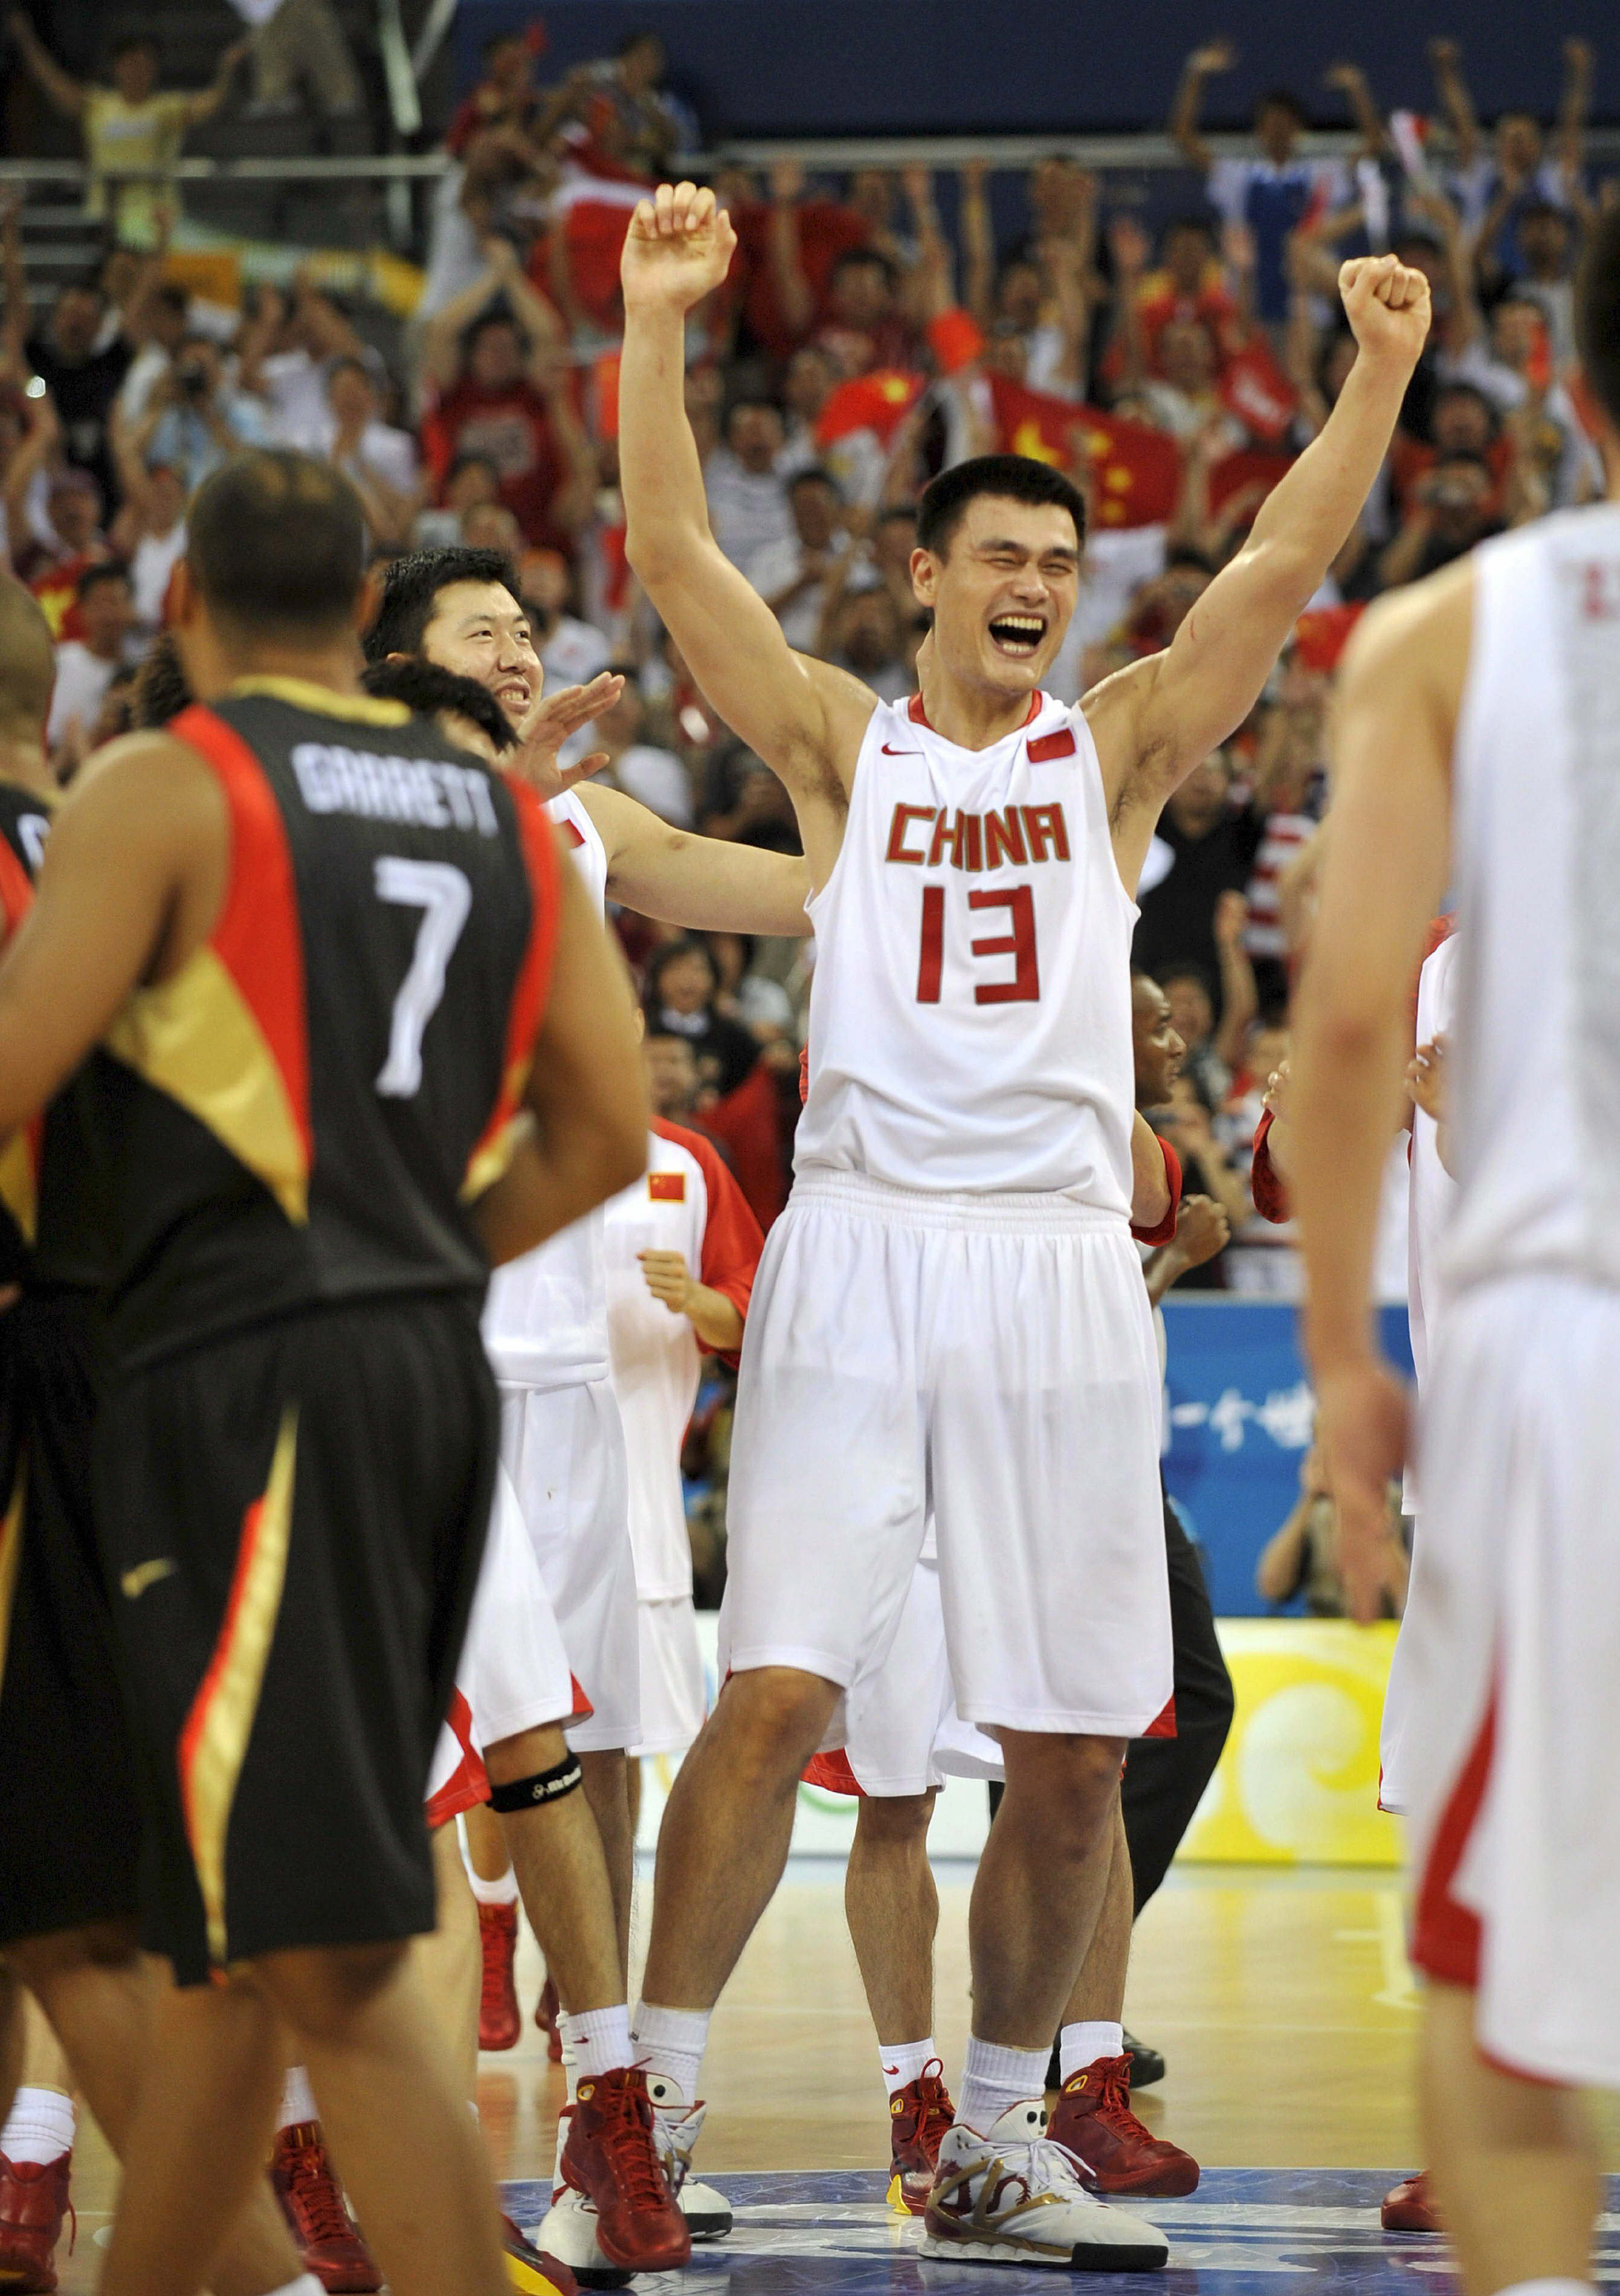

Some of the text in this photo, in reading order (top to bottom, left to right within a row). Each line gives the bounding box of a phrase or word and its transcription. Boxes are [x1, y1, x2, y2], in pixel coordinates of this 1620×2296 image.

[885, 802, 1071, 872] CHINA
[373, 854, 473, 1100] 7
[917, 885, 1040, 1005] 13
